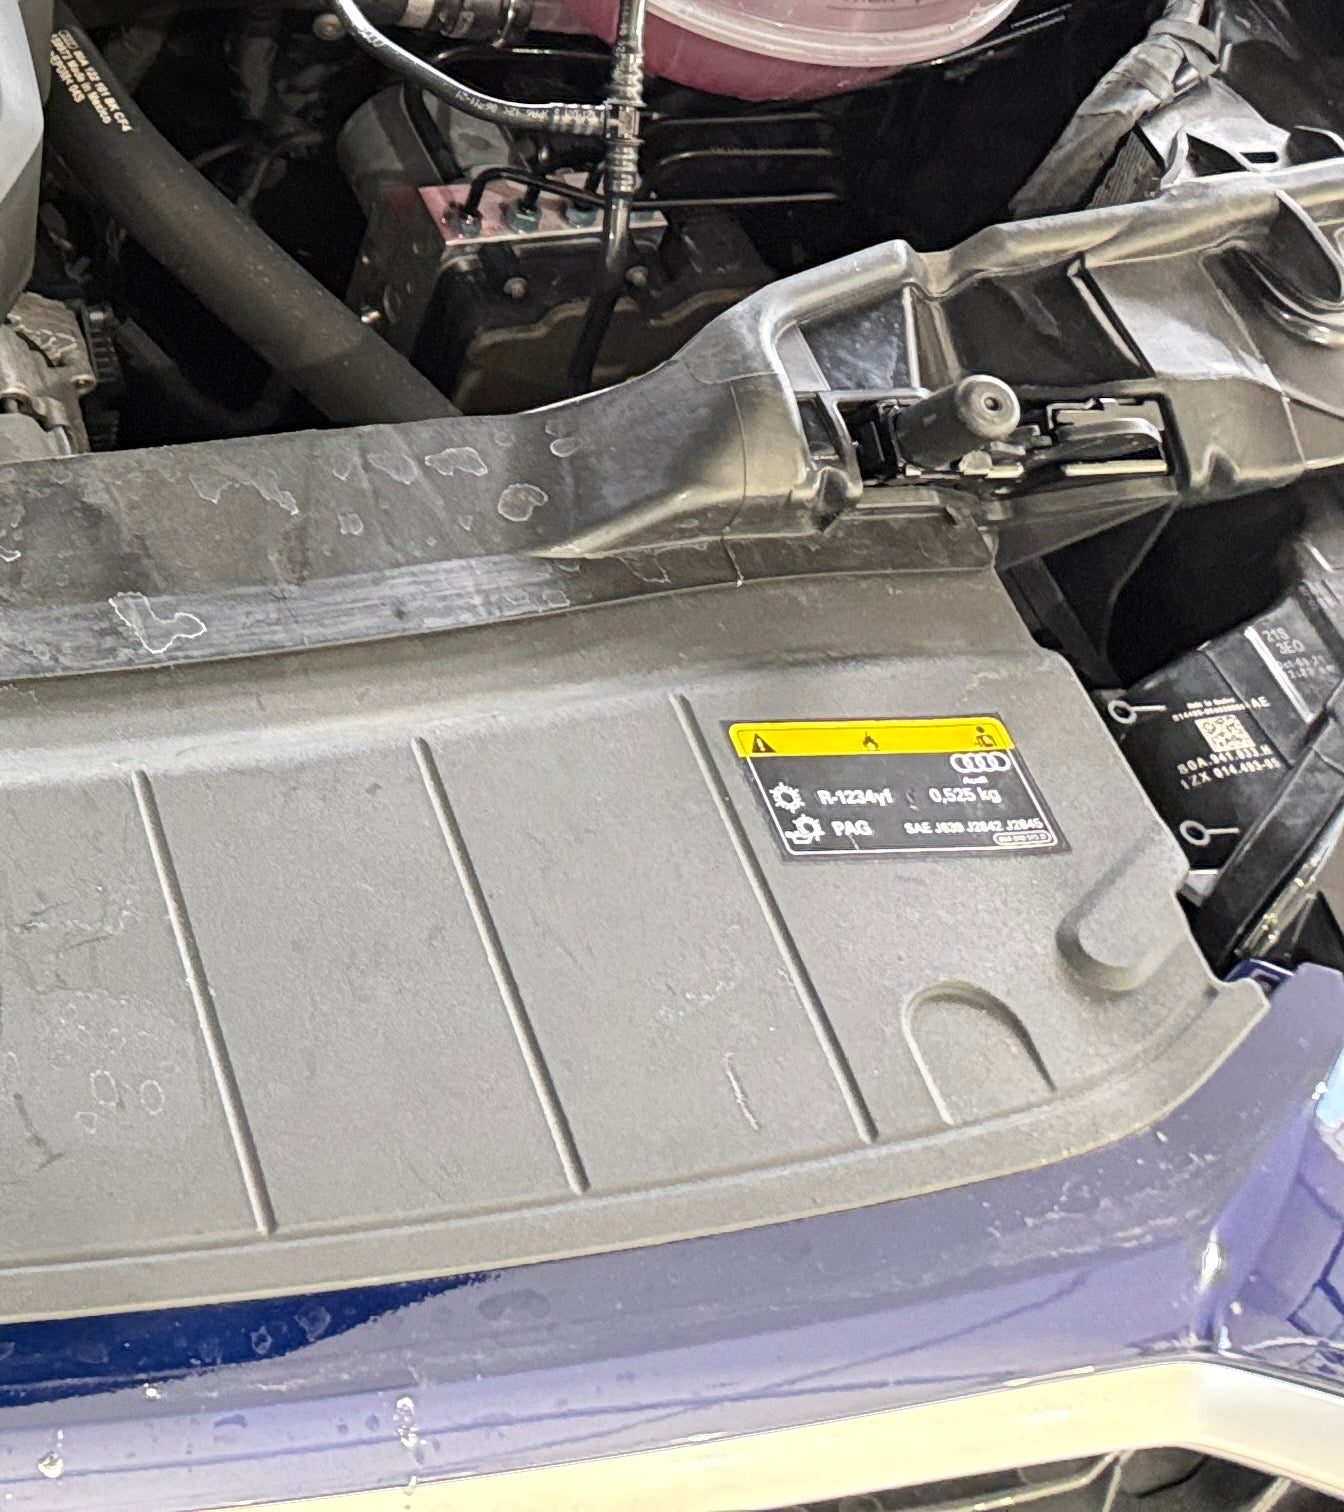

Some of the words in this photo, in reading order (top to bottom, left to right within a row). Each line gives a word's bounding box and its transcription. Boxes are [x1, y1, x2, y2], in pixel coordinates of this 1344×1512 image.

[1251, 696, 1271, 708] AE
[817, 789, 894, 806] R-1234yf
[929, 787, 978, 803] 0,525
[980, 787, 1001, 804] kg
[831, 821, 873, 836] PAG
[904, 823, 933, 834] SAE
